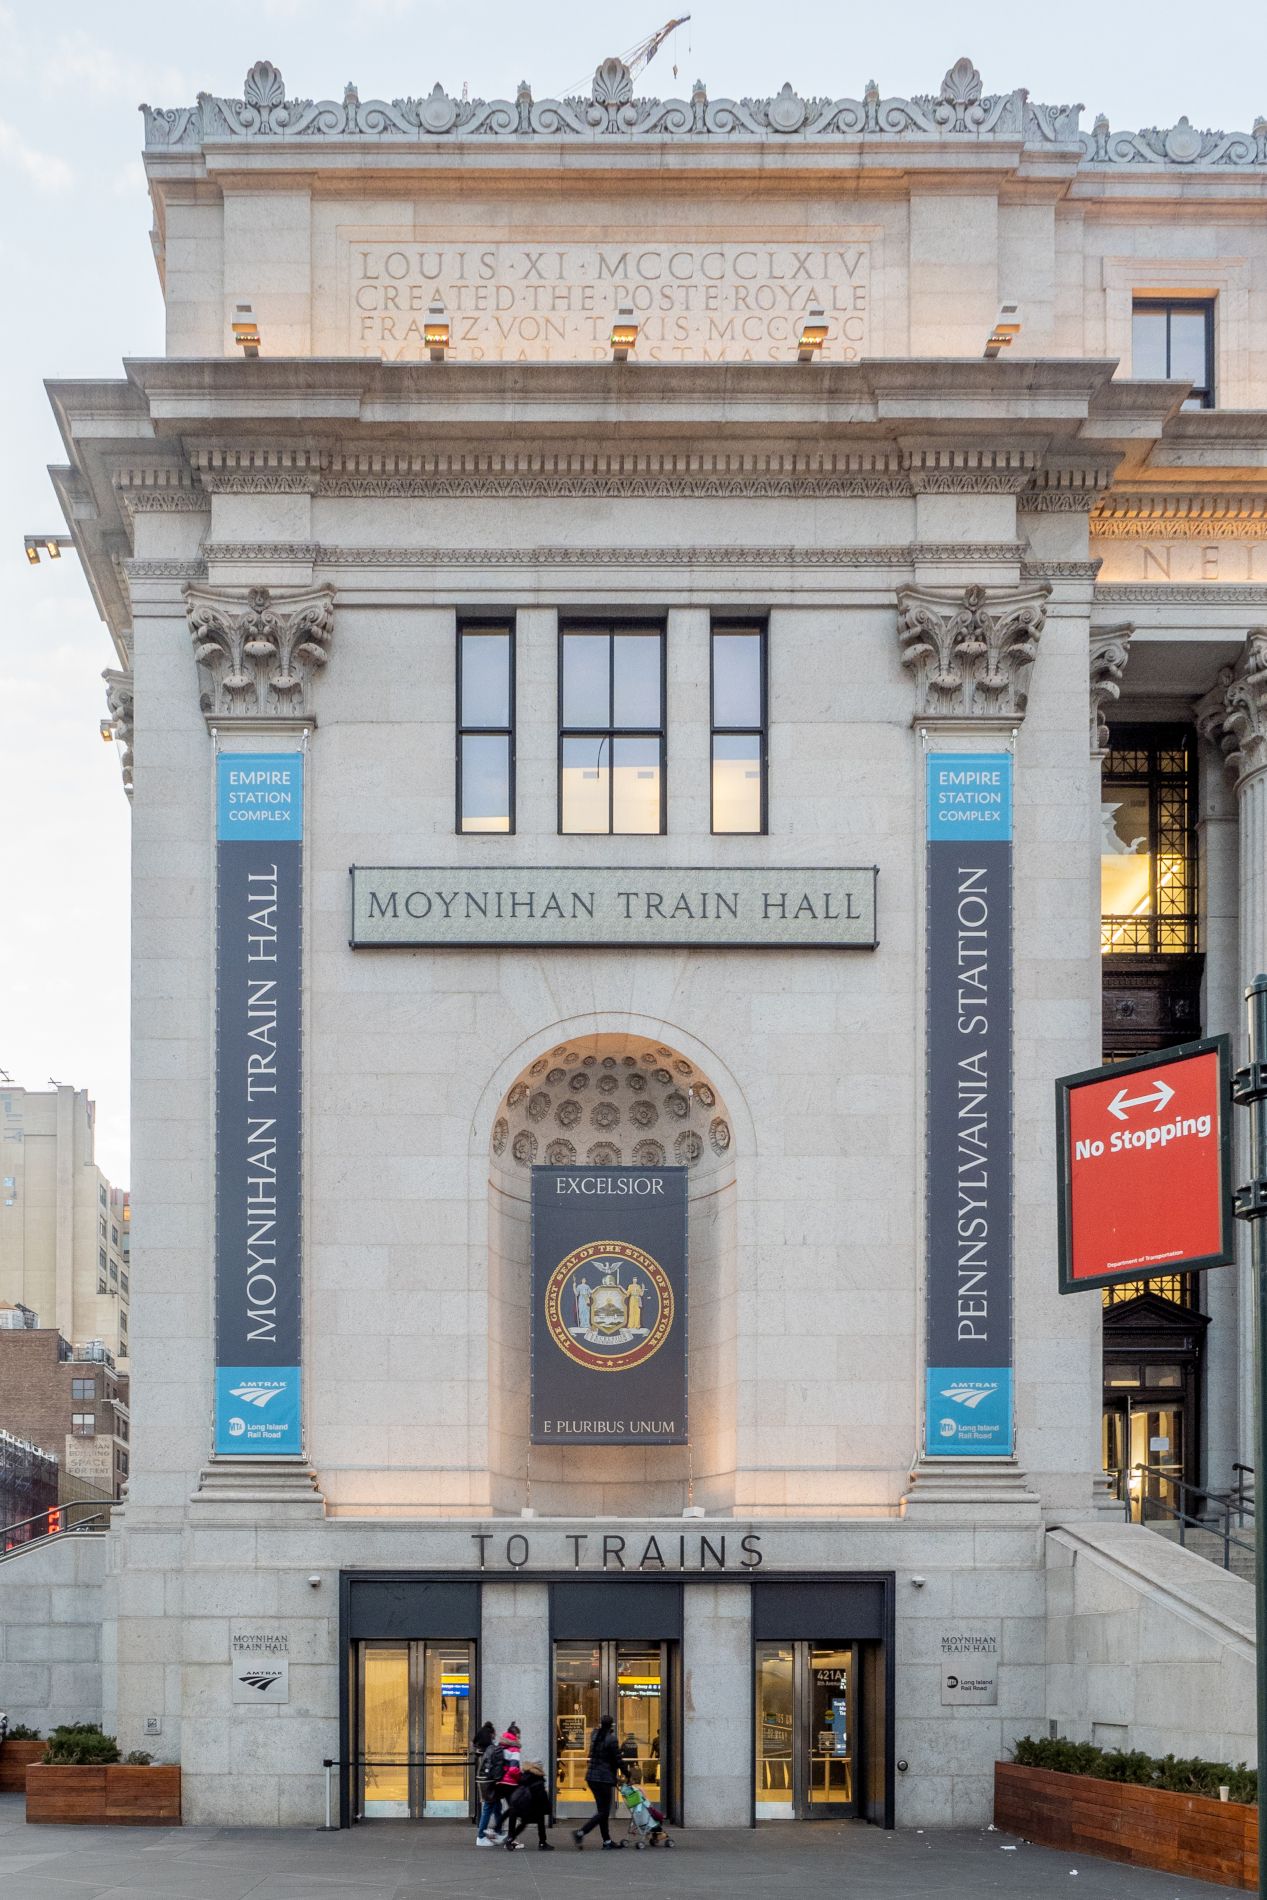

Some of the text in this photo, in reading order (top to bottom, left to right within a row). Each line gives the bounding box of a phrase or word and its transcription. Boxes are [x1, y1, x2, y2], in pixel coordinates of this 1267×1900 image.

[360, 252, 865, 281] LOUIS XI MCCCCLXIV
[356, 285, 867, 311] CREATED THE POSTE ROYALE
[492, 316, 567, 341] VON
[584, 316, 690, 341] TXIS
[229, 771, 291, 785] EMPIRE
[939, 771, 1001, 785] EMPIRE
[228, 792, 291, 804] STATION
[938, 792, 1001, 804] STATION
[229, 810, 291, 821] COMPLEX
[939, 810, 1001, 821] COMPLEX
[367, 890, 862, 920] MOYNIHAN TRAIN HALL
[246, 864, 278, 1342] MOYNIHAN TRAIN HALL
[957, 867, 988, 1342] PENNSYLVANIA STATION
[1075, 1114, 1211, 1161] No Stopping
[556, 1177, 665, 1195] EXCELSIOR
[549, 1285, 558, 1322] GREAT
[556, 1256, 579, 1281] SEAL
[580, 1247, 595, 1258] OF
[598, 1245, 621, 1253] THE
[624, 1248, 657, 1273] STATE
[655, 1275, 666, 1288] OF
[662, 1291, 670, 1317] NEW
[247, 1424, 265, 1432] Long
[544, 1420, 675, 1433] E PLURIBUS UNUM
[958, 1425, 976, 1433] Long
[471, 1534, 763, 1568] TO TRAINS
[233, 1635, 288, 1643] MOYNIHAN
[941, 1636, 996, 1644] MOYNIHAN
[233, 1643, 288, 1651] TRAIN HALL
[817, 1670, 842, 1680] 421A
